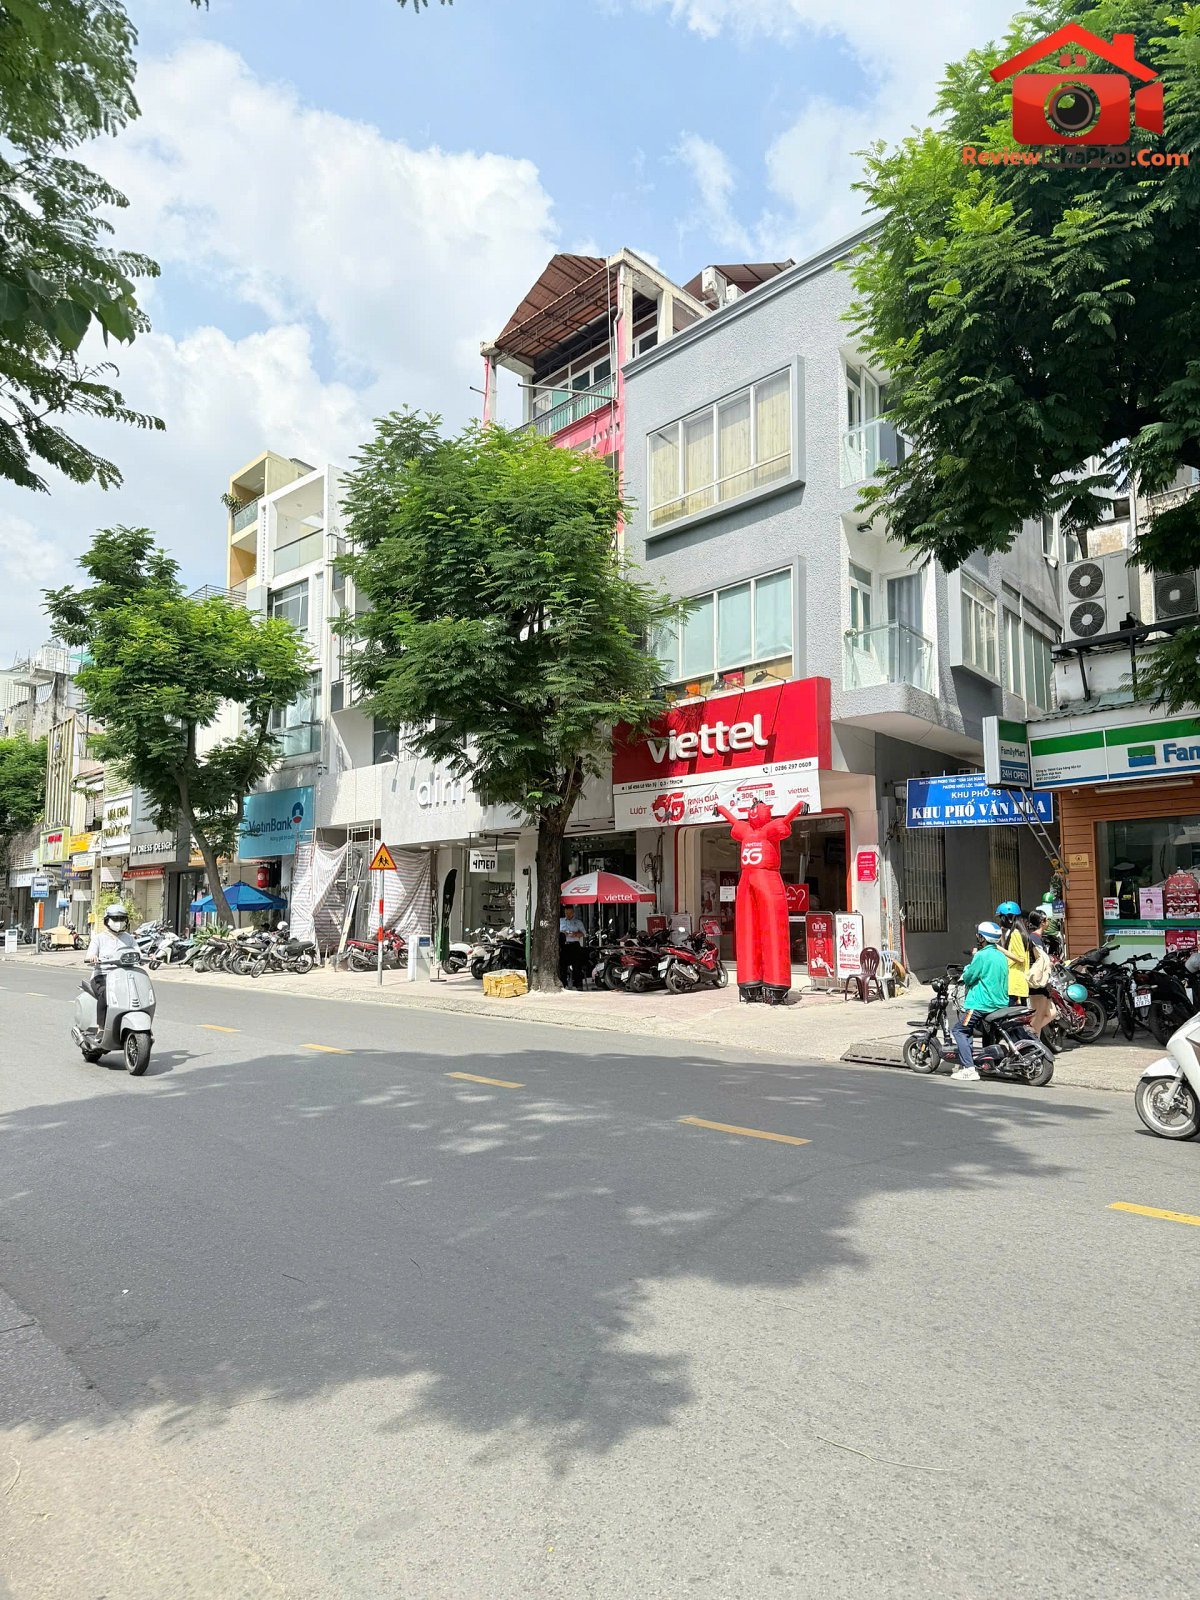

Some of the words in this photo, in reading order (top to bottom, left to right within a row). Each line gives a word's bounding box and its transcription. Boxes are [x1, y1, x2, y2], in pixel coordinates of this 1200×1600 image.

[647, 714, 768, 764] viettel
[1001, 746, 1026, 758] FamilyMart
[1001, 769, 1012, 778] 24H
[1013, 770, 1028, 780] OPEN
[951, 791, 969, 799] KHU
[971, 788, 990, 798] PHỐ
[652, 791, 685, 822] 5G
[687, 798, 703, 806] RINH
[912, 806, 941, 819] KHU
[945, 799, 975, 818] PHỐ
[979, 800, 1009, 816] VĂN
[249, 817, 292, 833] VietinBank
[741, 848, 763, 865] 5G
[604, 893, 633, 901] viettel
